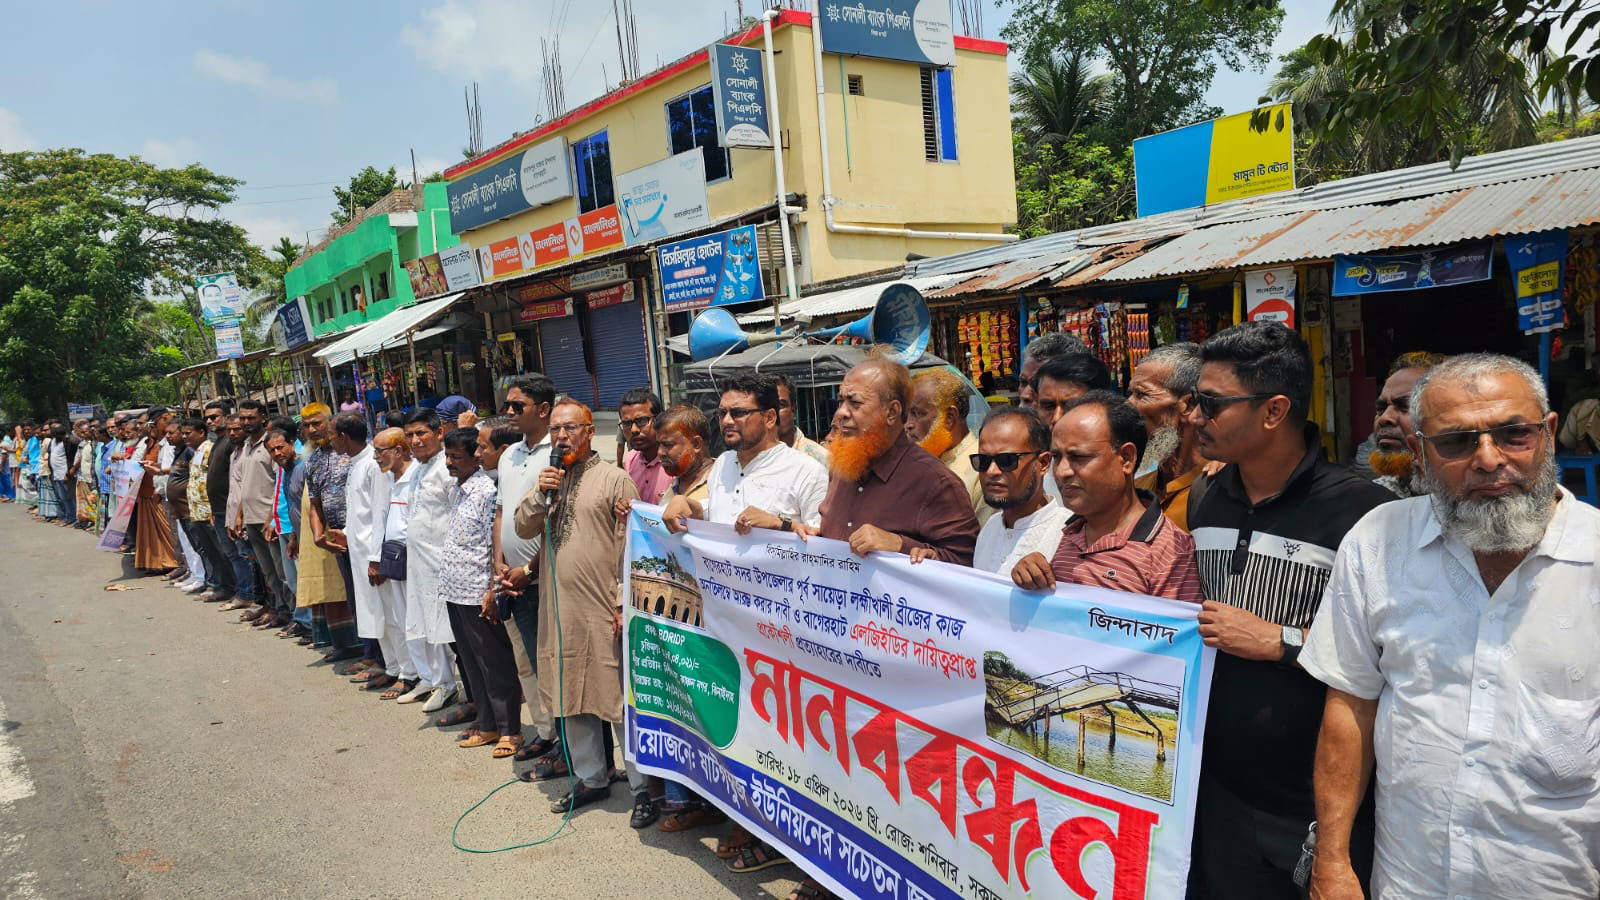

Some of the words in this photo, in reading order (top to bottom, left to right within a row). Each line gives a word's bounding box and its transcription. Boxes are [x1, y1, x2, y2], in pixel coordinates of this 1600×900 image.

[842, 2, 866, 25] সোনালী
[867, 9, 885, 28] ব্যাংক
[726, 76, 759, 90] সোনালী
[729, 90, 756, 102] ব্যাংক
[727, 100, 763, 116] পিএলসি
[1233, 168, 1255, 182] মামুন
[1257, 163, 1266, 176] টি
[582, 216, 617, 235] বাংলালিংক
[535, 233, 565, 250] বাংলালিংক
[697, 240, 722, 260] হোটেল
[493, 246, 519, 261] বাংলালিংক
[800, 553, 835, 569] রাহমানির
[837, 557, 861, 573] রাহিম
[702, 556, 732, 577] বাগেরহাট
[733, 565, 752, 584] সদর
[752, 564, 795, 595] উপজেলার
[797, 575, 810, 604] পূর্ব
[811, 582, 847, 610] সায়েড়া
[895, 596, 933, 632] ব্রীজের
[935, 613, 967, 640] কাজ
[1088, 607, 1179, 645] জিন্দাবাদ
[752, 594, 774, 614] করার
[774, 597, 791, 622] দাবী
[794, 609, 801, 623] ও
[802, 610, 848, 638] বাগেরহাট
[849, 620, 909, 660] এলজিইডির
[912, 637, 977, 681] দায়িত্বপ্রাপ্ত
[795, 636, 843, 665] প্রত্যাহারের
[844, 649, 882, 678] দাবীতে
[744, 648, 1160, 900] মানববন্ধন
[756, 750, 785, 776] তারিখ:
[787, 765, 801, 784] ১৮
[804, 774, 830, 802] এপ্রিল
[832, 792, 863, 822] ২০২৬
[866, 806, 882, 836] খ্রি.
[885, 823, 914, 853] রোজ:
[750, 773, 834, 861] ইউনিয়নের
[837, 831, 903, 900] সচেতন
